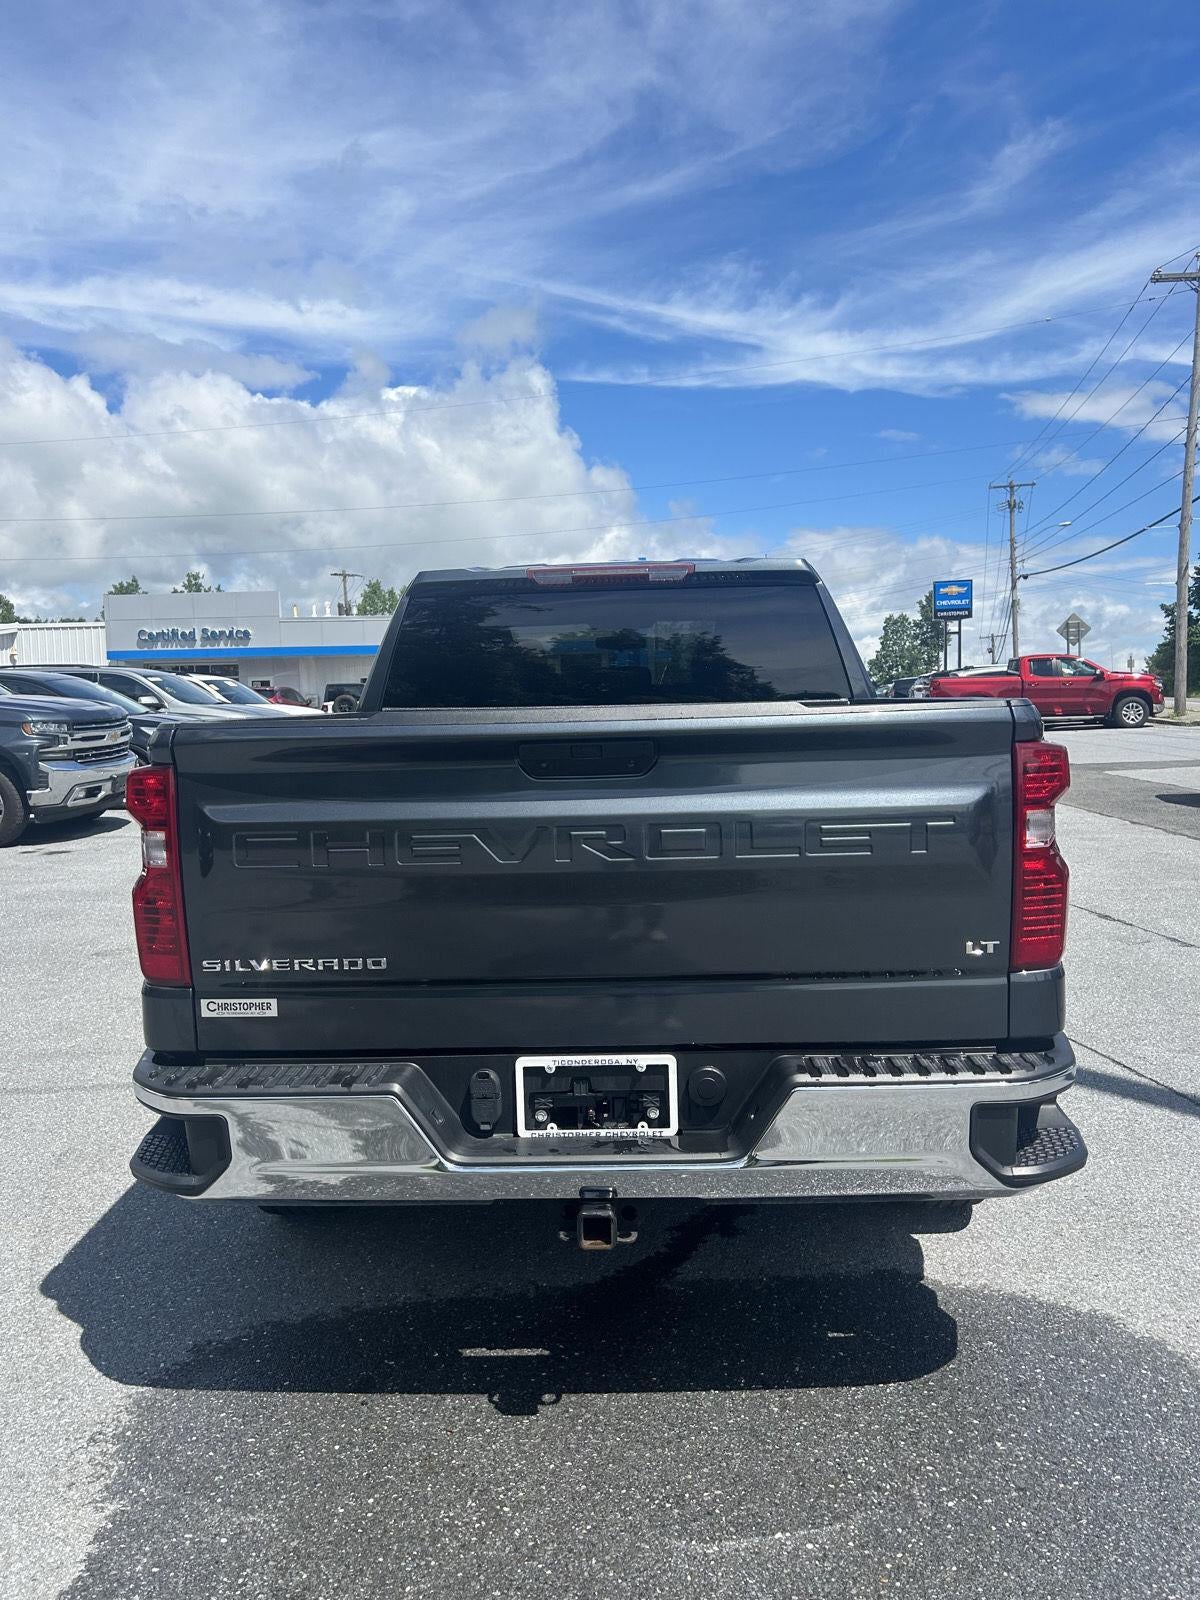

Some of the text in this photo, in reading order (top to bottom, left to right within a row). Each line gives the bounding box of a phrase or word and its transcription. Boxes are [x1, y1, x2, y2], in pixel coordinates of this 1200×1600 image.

[137, 627, 251, 642] Certified Service
[232, 816, 956, 868] CHEVROLET
[965, 940, 1000, 955] LT
[202, 957, 388, 972] SILVERADO
[206, 1001, 272, 1012] CHRISTOPHER
[605, 1130, 664, 1138] CHEVROLET
